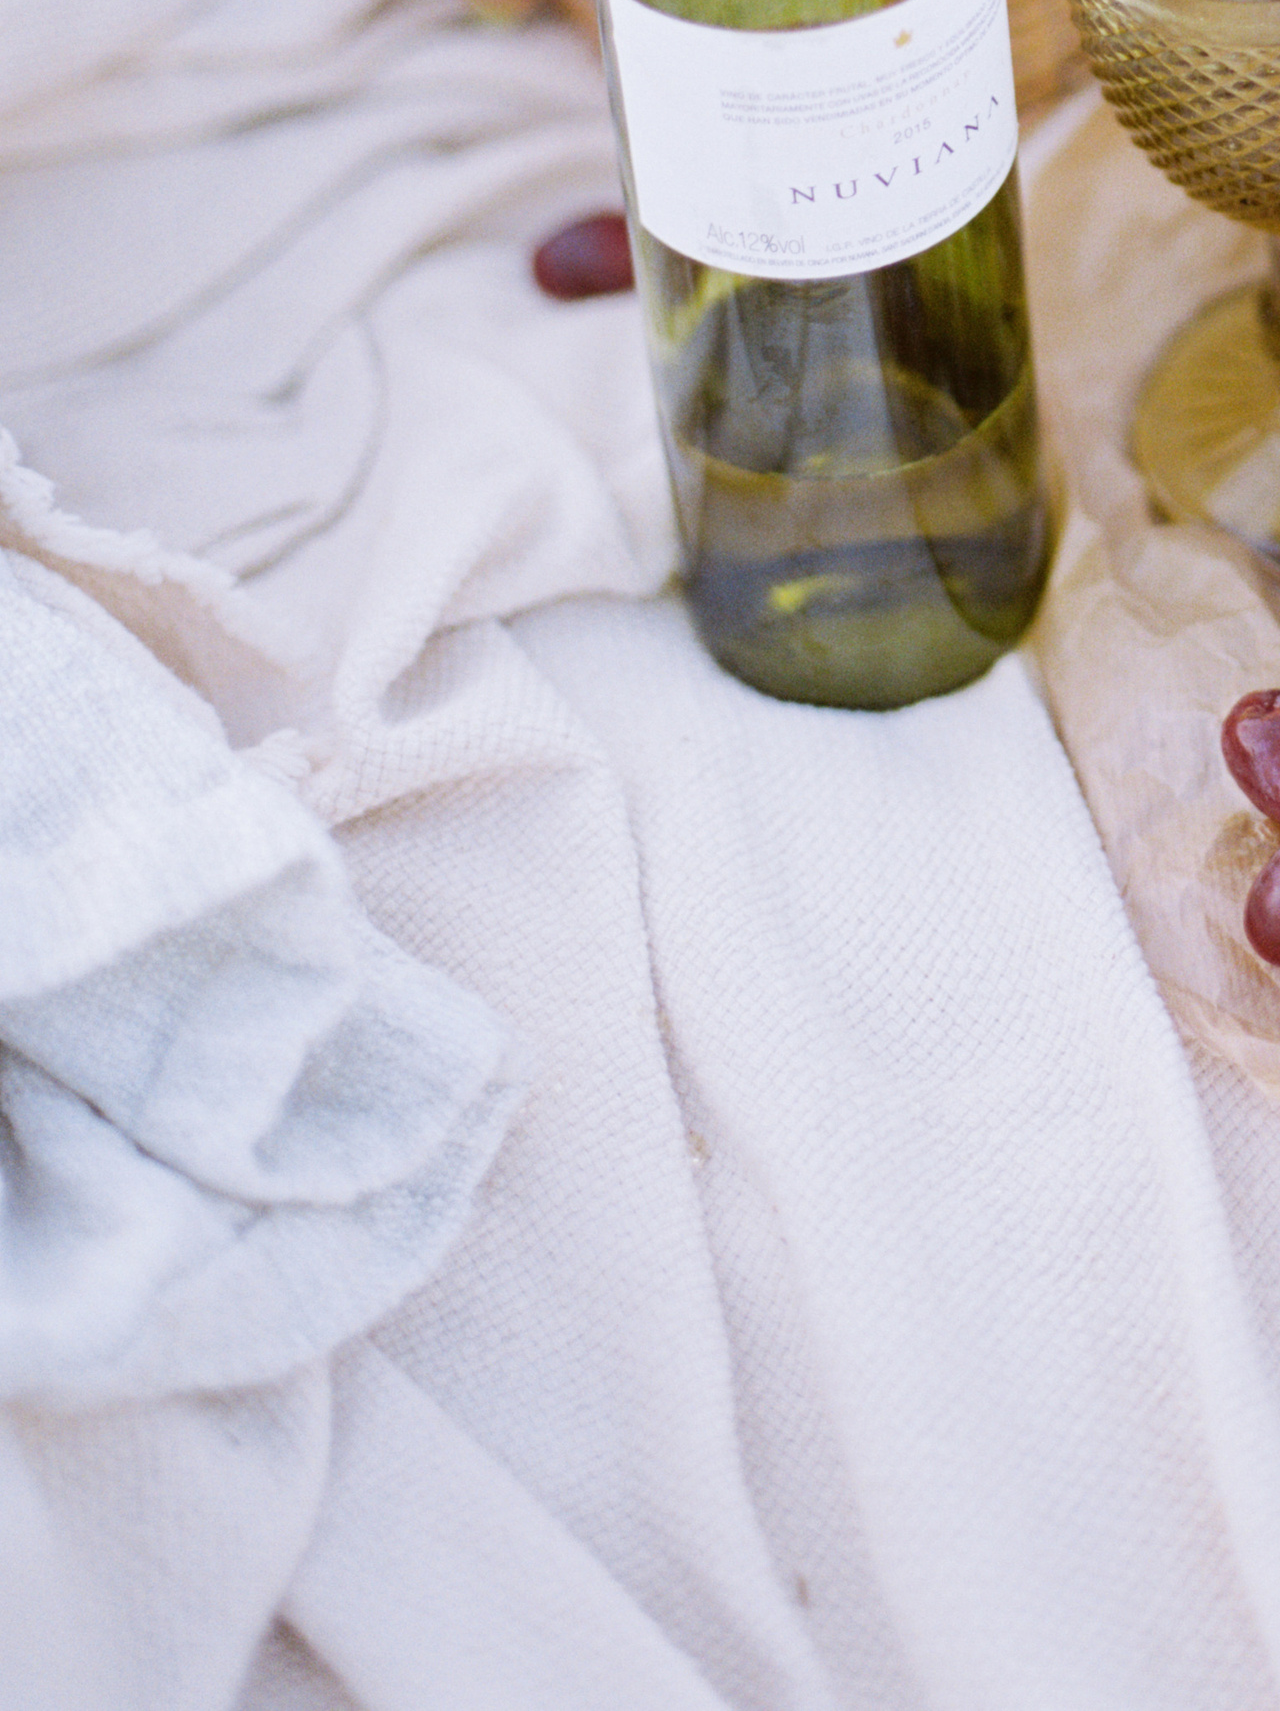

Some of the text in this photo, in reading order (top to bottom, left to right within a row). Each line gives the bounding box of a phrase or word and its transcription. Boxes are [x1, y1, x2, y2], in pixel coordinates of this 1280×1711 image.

[747, 114, 771, 125] HAN
[773, 116, 801, 126] SIDO
[879, 96, 893, 107] EN
[893, 116, 931, 144] 2015
[789, 95, 998, 205] NUVIANA
[858, 233, 883, 246] VINO
[886, 229, 899, 239] DE
[902, 222, 915, 233] LA
